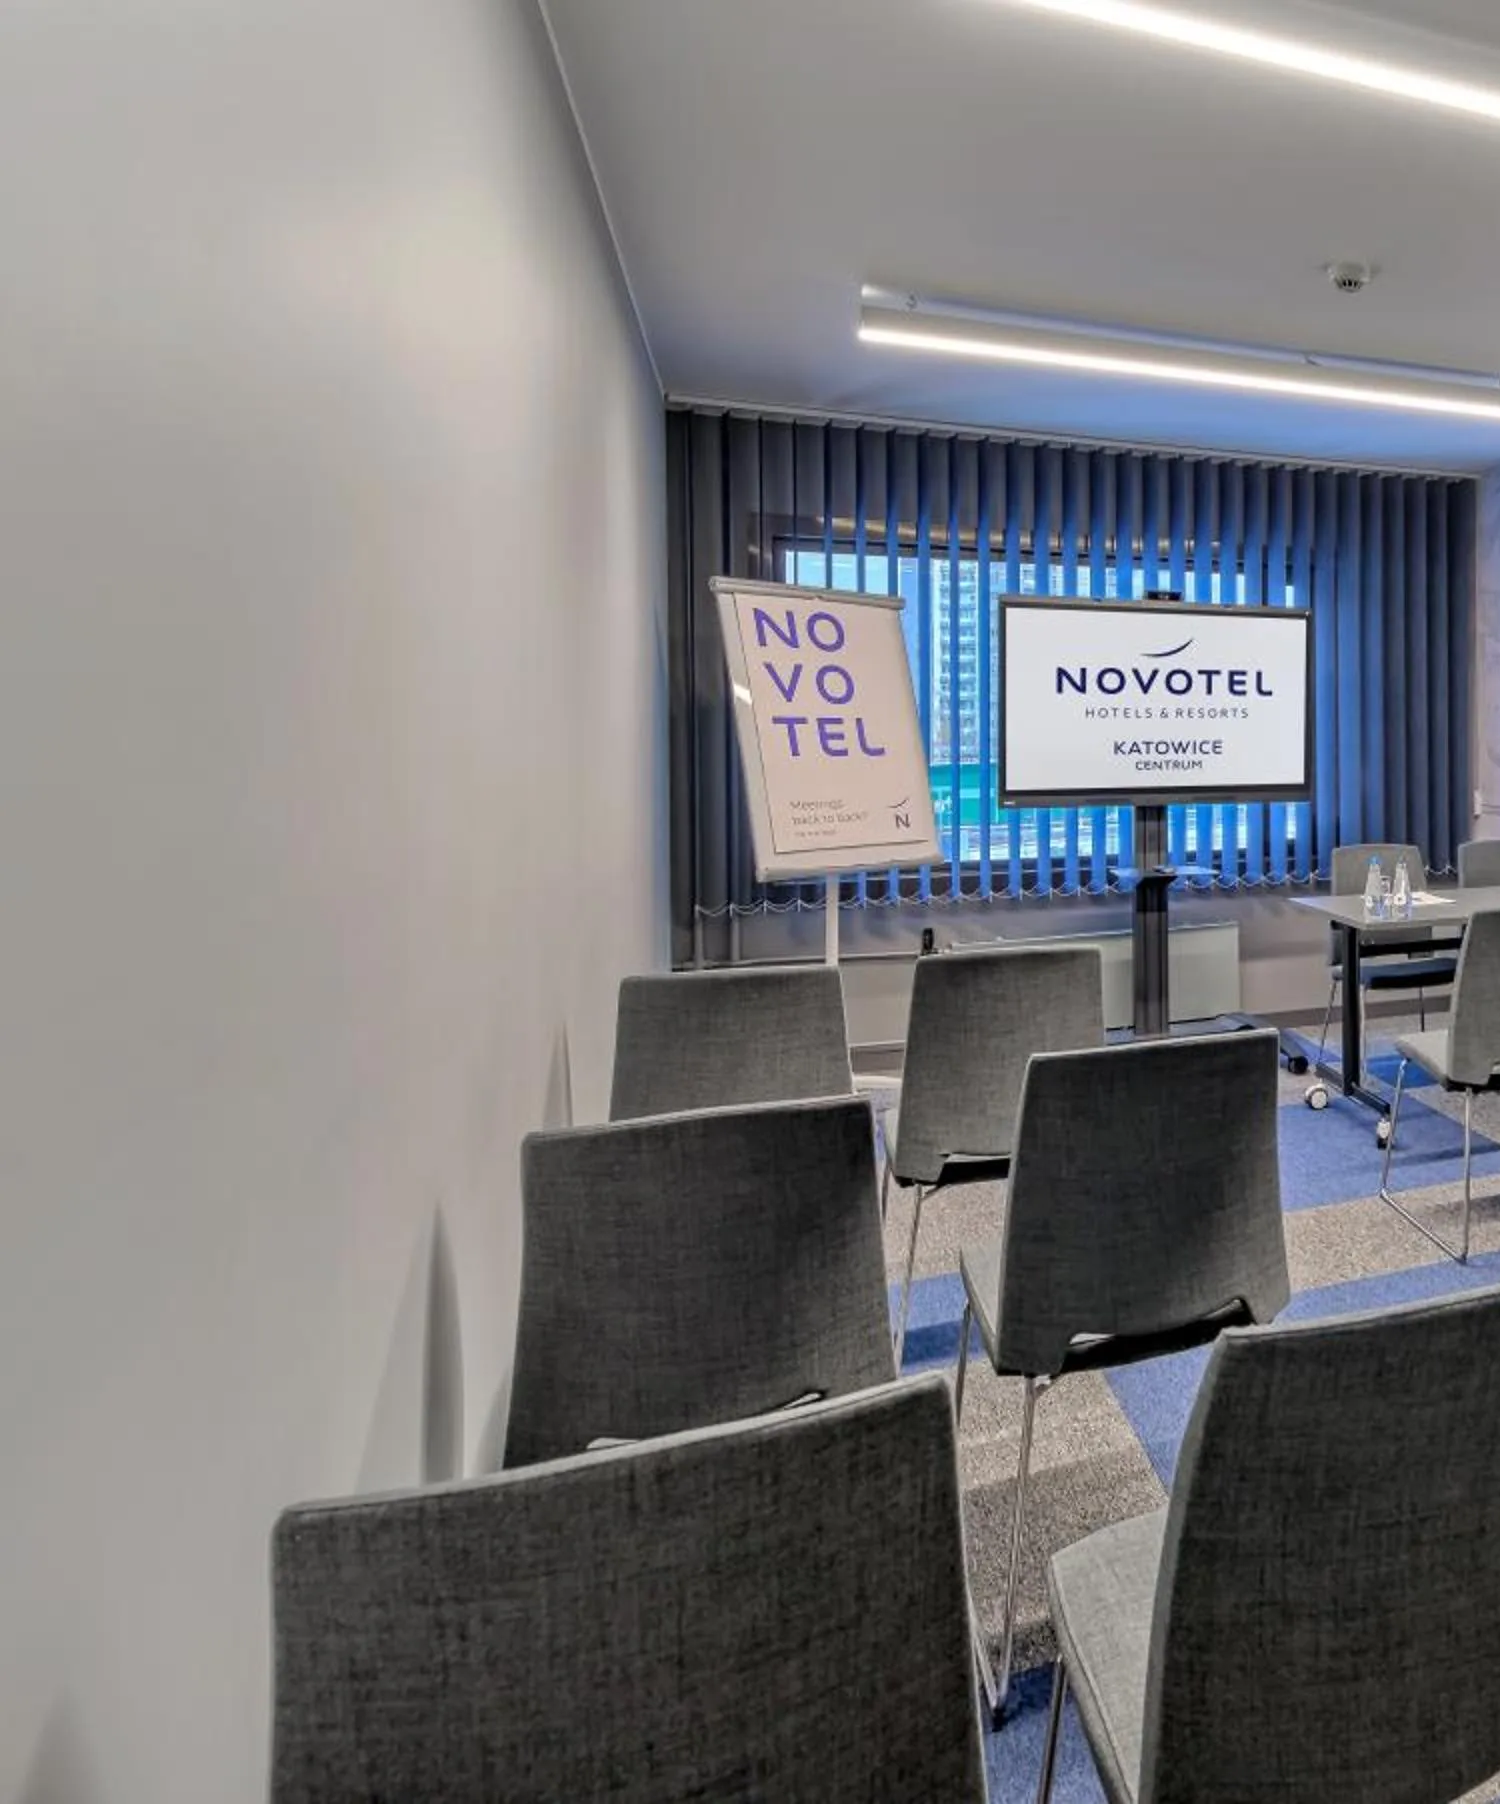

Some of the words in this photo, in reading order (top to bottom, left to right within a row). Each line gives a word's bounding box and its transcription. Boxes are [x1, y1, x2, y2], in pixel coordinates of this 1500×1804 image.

[753, 607, 845, 653] NO
[763, 662, 855, 705] VO
[1056, 666, 1273, 696] NOVOTEL
[1085, 706, 1153, 719] HOTELS
[1160, 708, 1169, 719] &
[1175, 707, 1249, 719] RESORTS
[772, 716, 886, 758] TEL
[1113, 739, 1223, 755] KATOWICE
[1135, 760, 1203, 771] CENTRUM
